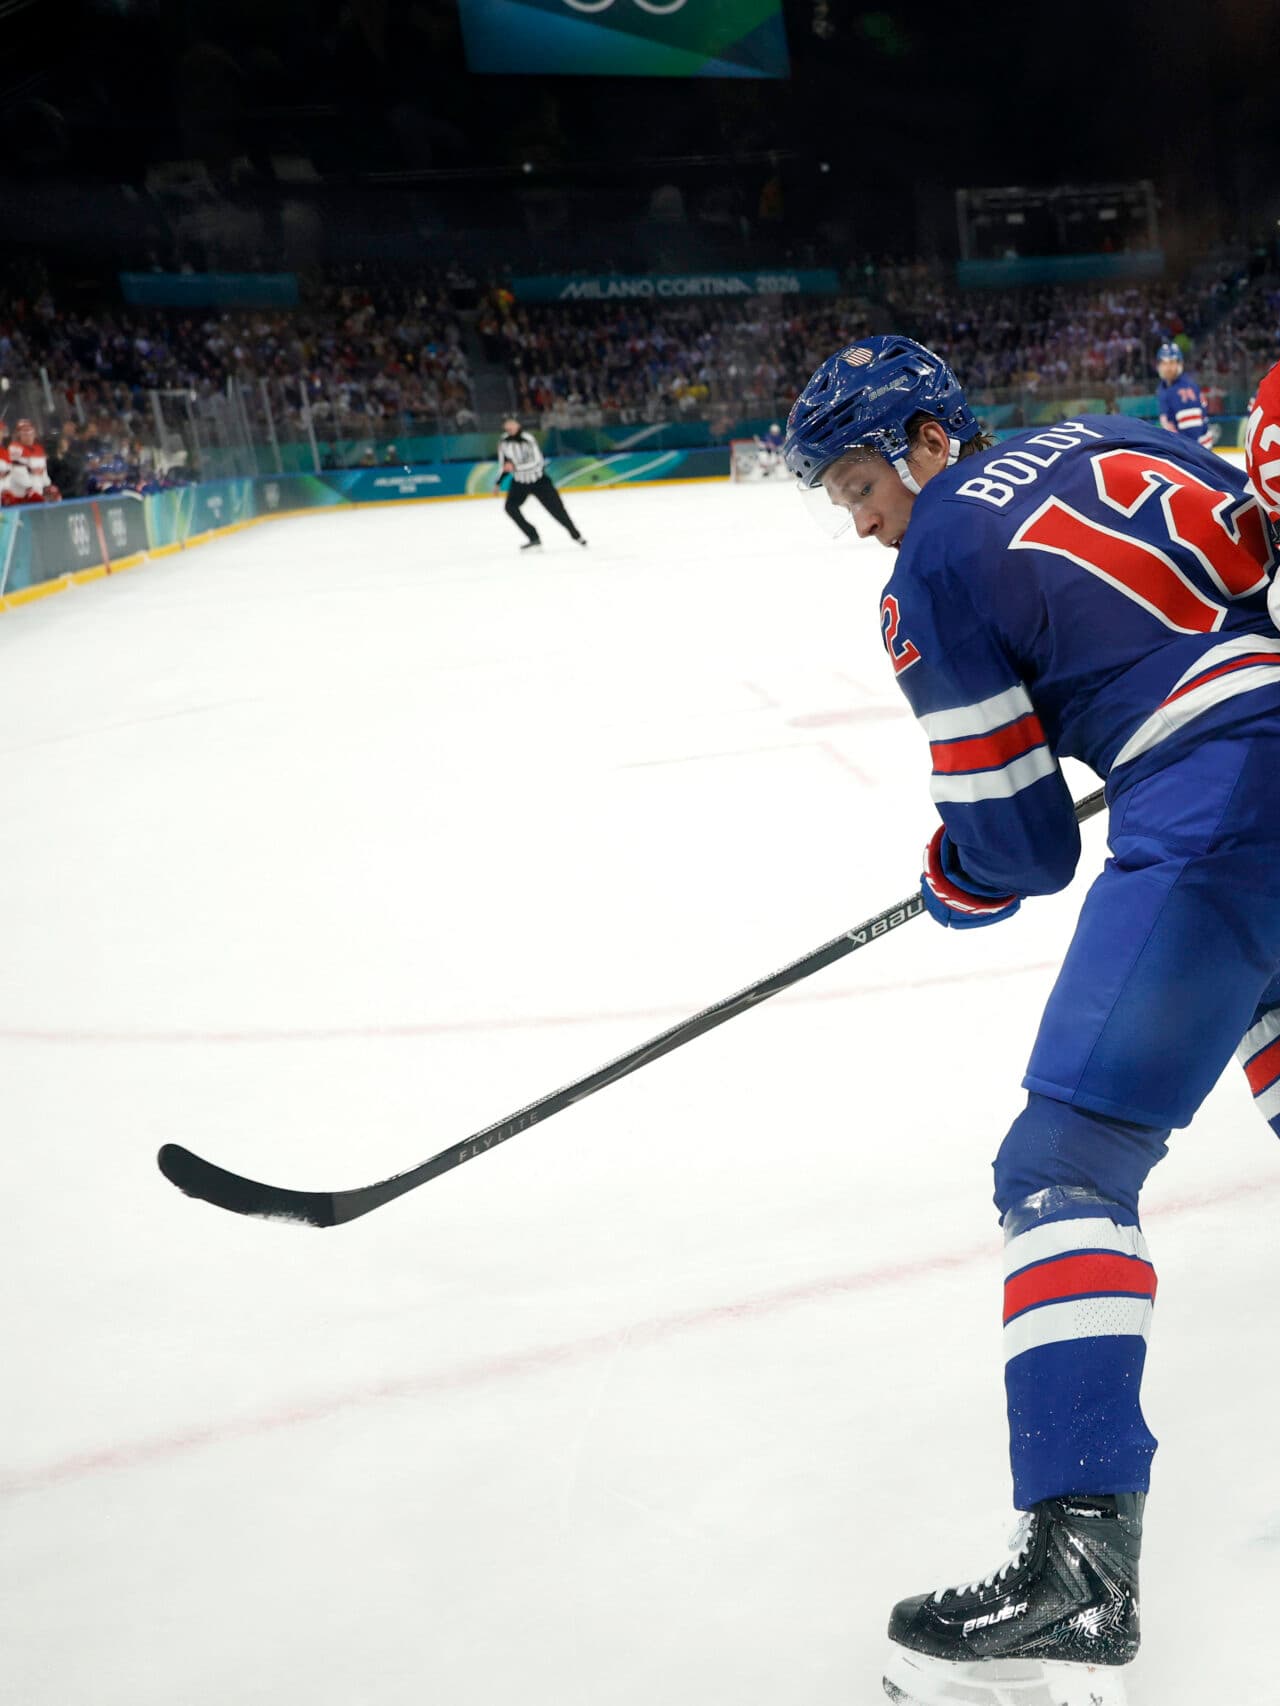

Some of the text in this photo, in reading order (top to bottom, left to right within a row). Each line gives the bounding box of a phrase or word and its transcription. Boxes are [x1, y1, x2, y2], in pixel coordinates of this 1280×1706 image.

[560, 275, 799, 299] MILANO CORTINA 2026
[955, 421, 1104, 508] BOLDY
[1007, 448, 1274, 634] 12
[459, 1111, 539, 1163] FLYLITE
[962, 1601, 1029, 1638] BAUER
